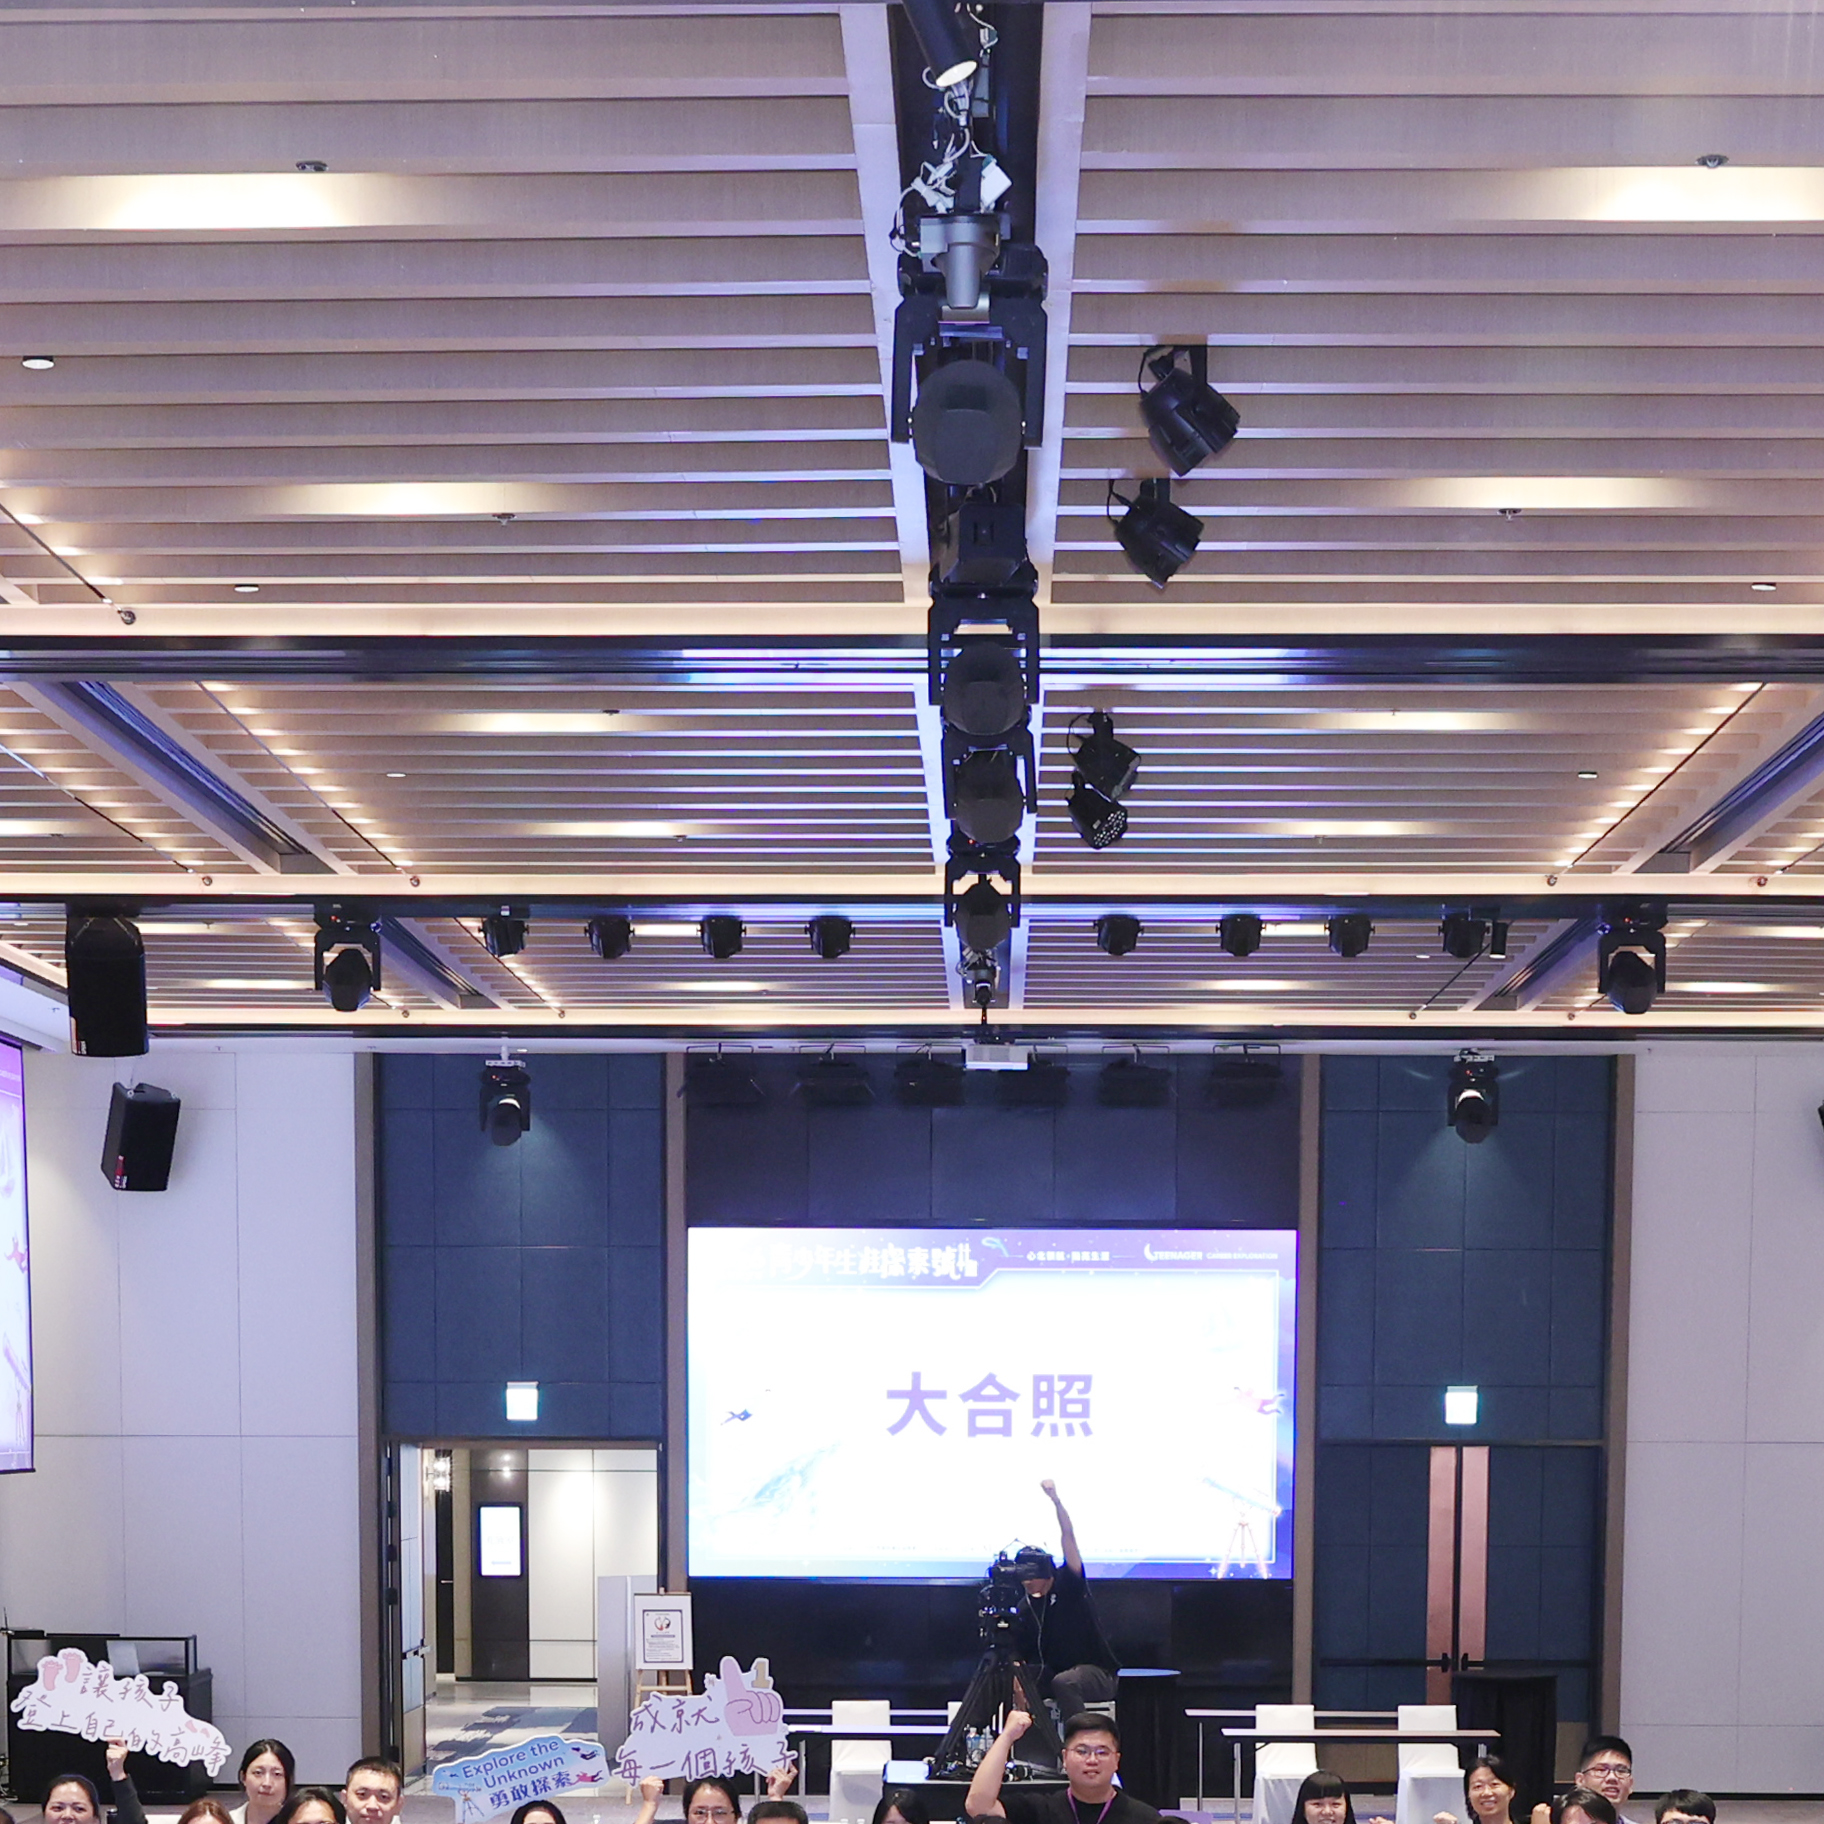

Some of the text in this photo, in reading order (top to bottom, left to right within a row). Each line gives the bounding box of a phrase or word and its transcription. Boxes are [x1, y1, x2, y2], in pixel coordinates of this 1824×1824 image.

[886, 1371, 1094, 1438] 大合照
[80, 1666, 180, 1712] 讓孩子
[15, 1690, 231, 1774] 登上自己的高峰
[632, 1695, 720, 1735] 成就
[462, 1738, 560, 1779] Explore the
[483, 1754, 564, 1789] Unknown
[616, 1742, 798, 1786] 每一個孩子
[488, 1772, 577, 1809] 勇敢探索
